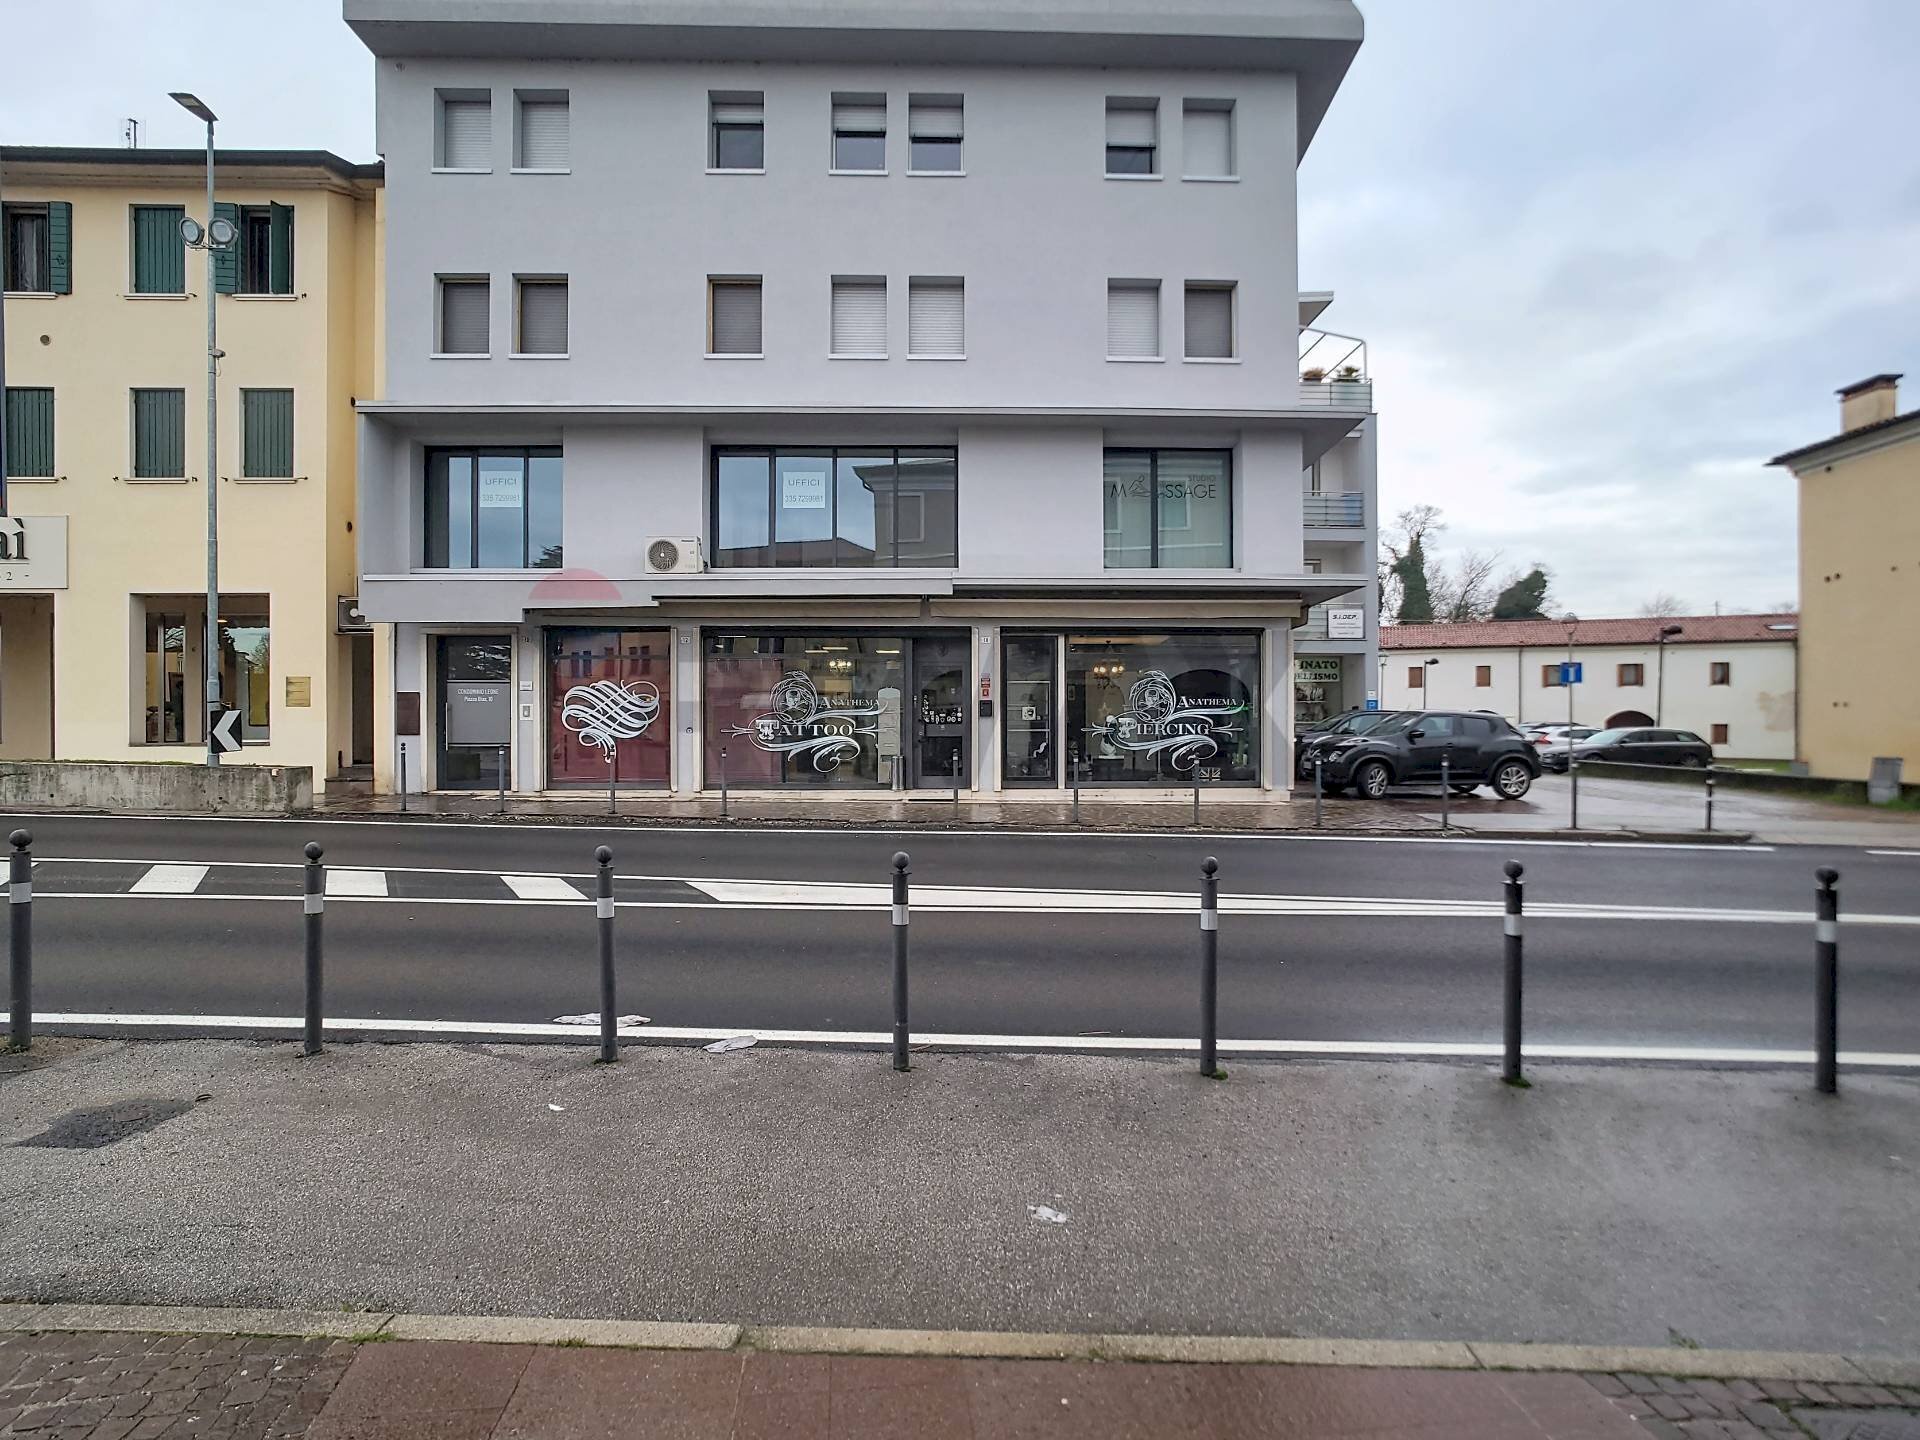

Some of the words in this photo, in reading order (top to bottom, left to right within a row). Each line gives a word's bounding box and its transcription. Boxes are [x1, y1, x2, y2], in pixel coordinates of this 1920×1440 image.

[485, 477, 517, 486] UFFICI
[788, 478, 820, 487] UFFICI
[818, 697, 879, 709] ANATHEMA
[1176, 696, 1238, 708] ANATHEMA
[755, 719, 853, 740] TATTOO
[1118, 718, 1211, 739] PIERCING
